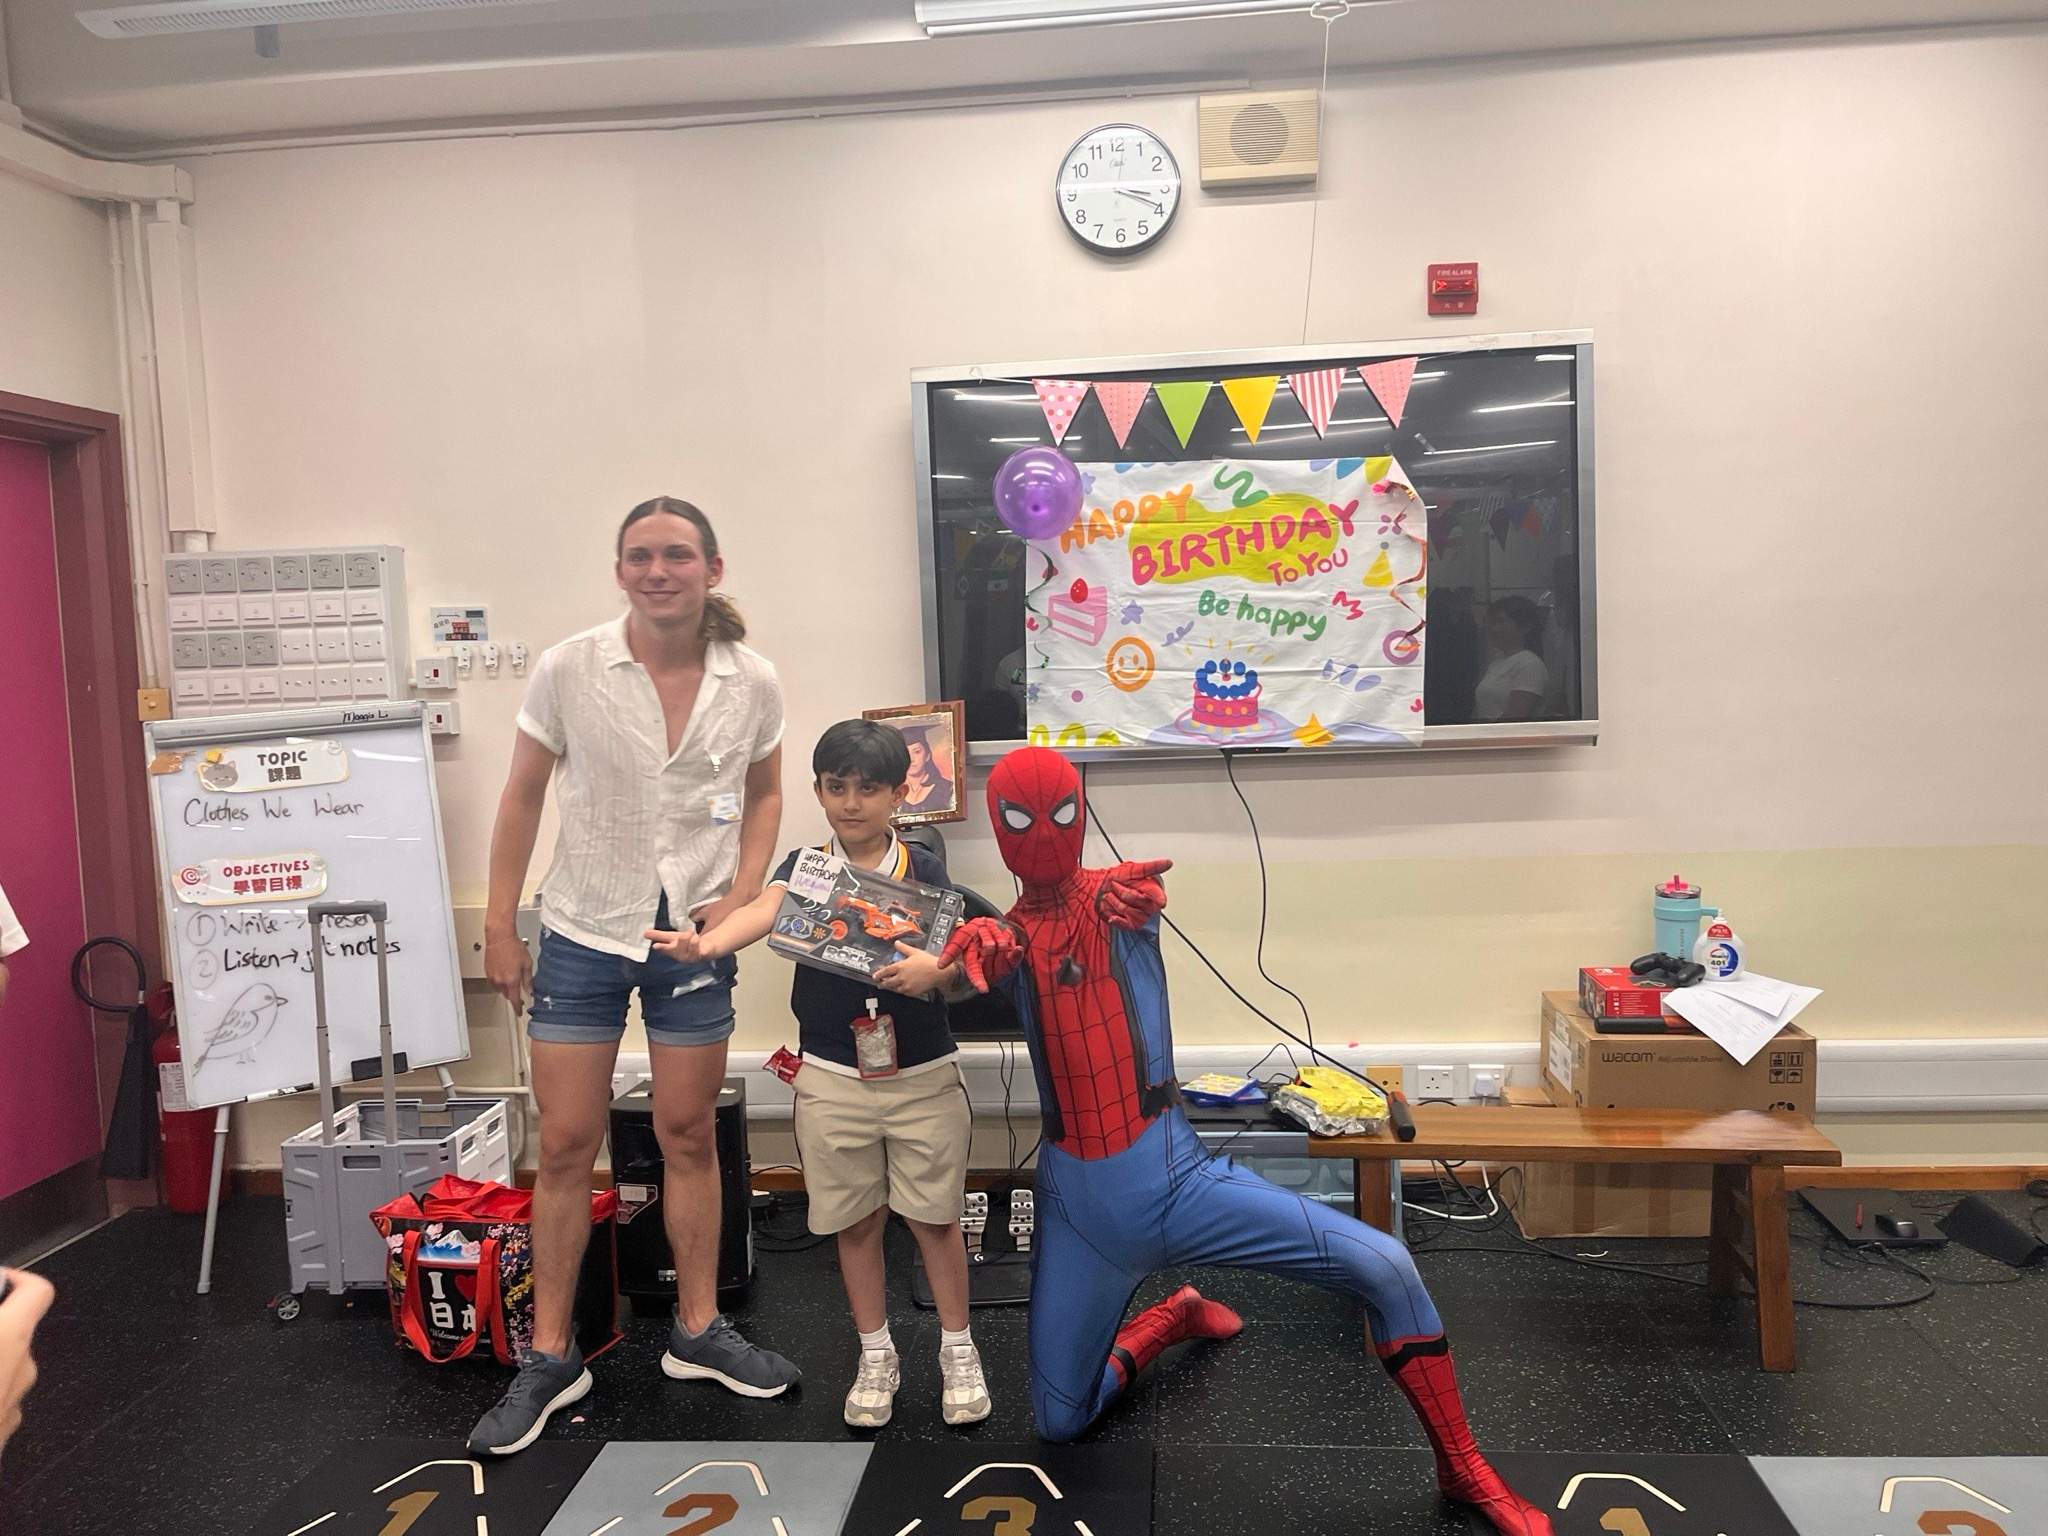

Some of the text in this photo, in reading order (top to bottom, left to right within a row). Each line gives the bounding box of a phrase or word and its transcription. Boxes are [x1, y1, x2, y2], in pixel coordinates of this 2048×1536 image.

[1089, 144, 1102, 160] 11
[1136, 141, 1143, 157] 1
[1072, 162, 1089, 179] 10
[1151, 156, 1162, 172] 2
[1075, 209, 1087, 224] 8
[1153, 202, 1165, 217] 4
[1093, 223, 1104, 239] 7
[1115, 228, 1126, 243] 6
[1137, 220, 1149, 235] 5
[1060, 483, 1194, 554] HAPPY
[1131, 499, 1360, 586] BIRTHDAY
[1198, 589, 1327, 642] Be happy
[257, 750, 308, 766] TOPIC
[268, 765, 301, 783] 課題
[184, 793, 365, 826] Clothes We Wear
[223, 860, 310, 877] OBJECTIVES
[221, 913, 279, 937] Write
[224, 948, 280, 972] Listen
[1601, 1051, 1653, 1063] wacom
[428, 1272, 446, 1300] I
